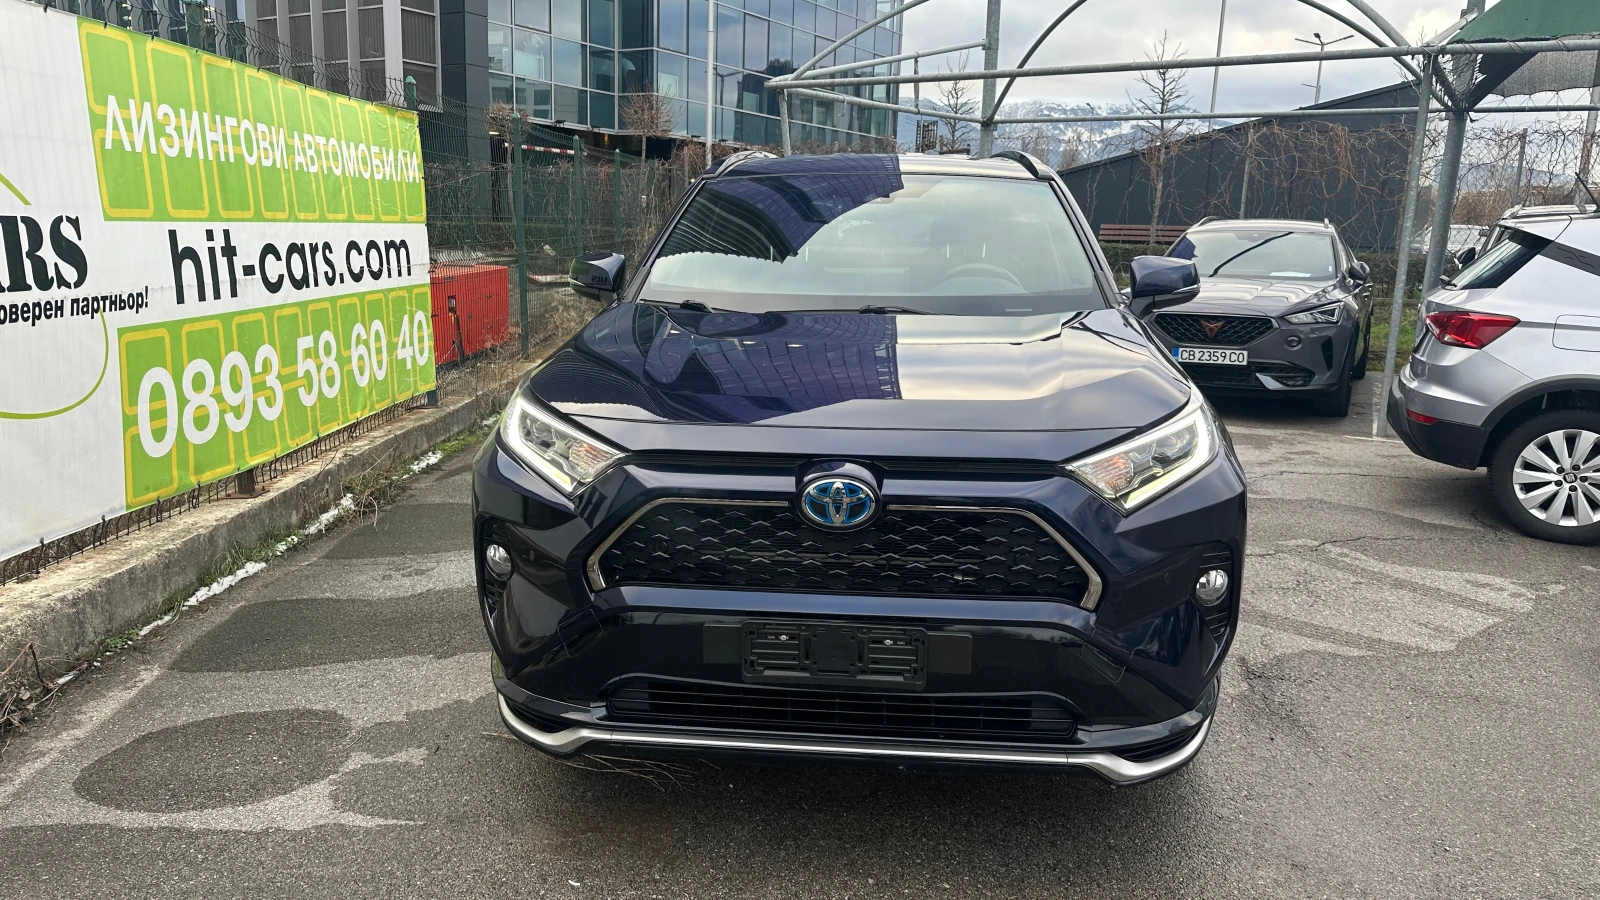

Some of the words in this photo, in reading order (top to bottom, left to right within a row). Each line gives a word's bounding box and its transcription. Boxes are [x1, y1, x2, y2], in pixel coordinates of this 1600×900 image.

[105, 95, 288, 169] ЛИЗИНГОВИ
[293, 131, 420, 183] АВТОМОБИЛИ
[0, 215, 88, 293] RS
[168, 229, 412, 305] hit-cars.com
[70, 286, 149, 319] партньор!
[138, 343, 283, 458] 0893
[297, 330, 341, 407] 58
[351, 319, 387, 387] 60
[397, 310, 429, 370] 40
[1180, 350, 1196, 361] CB
[1198, 351, 1227, 362] 2359
[1229, 353, 1245, 363] CO
